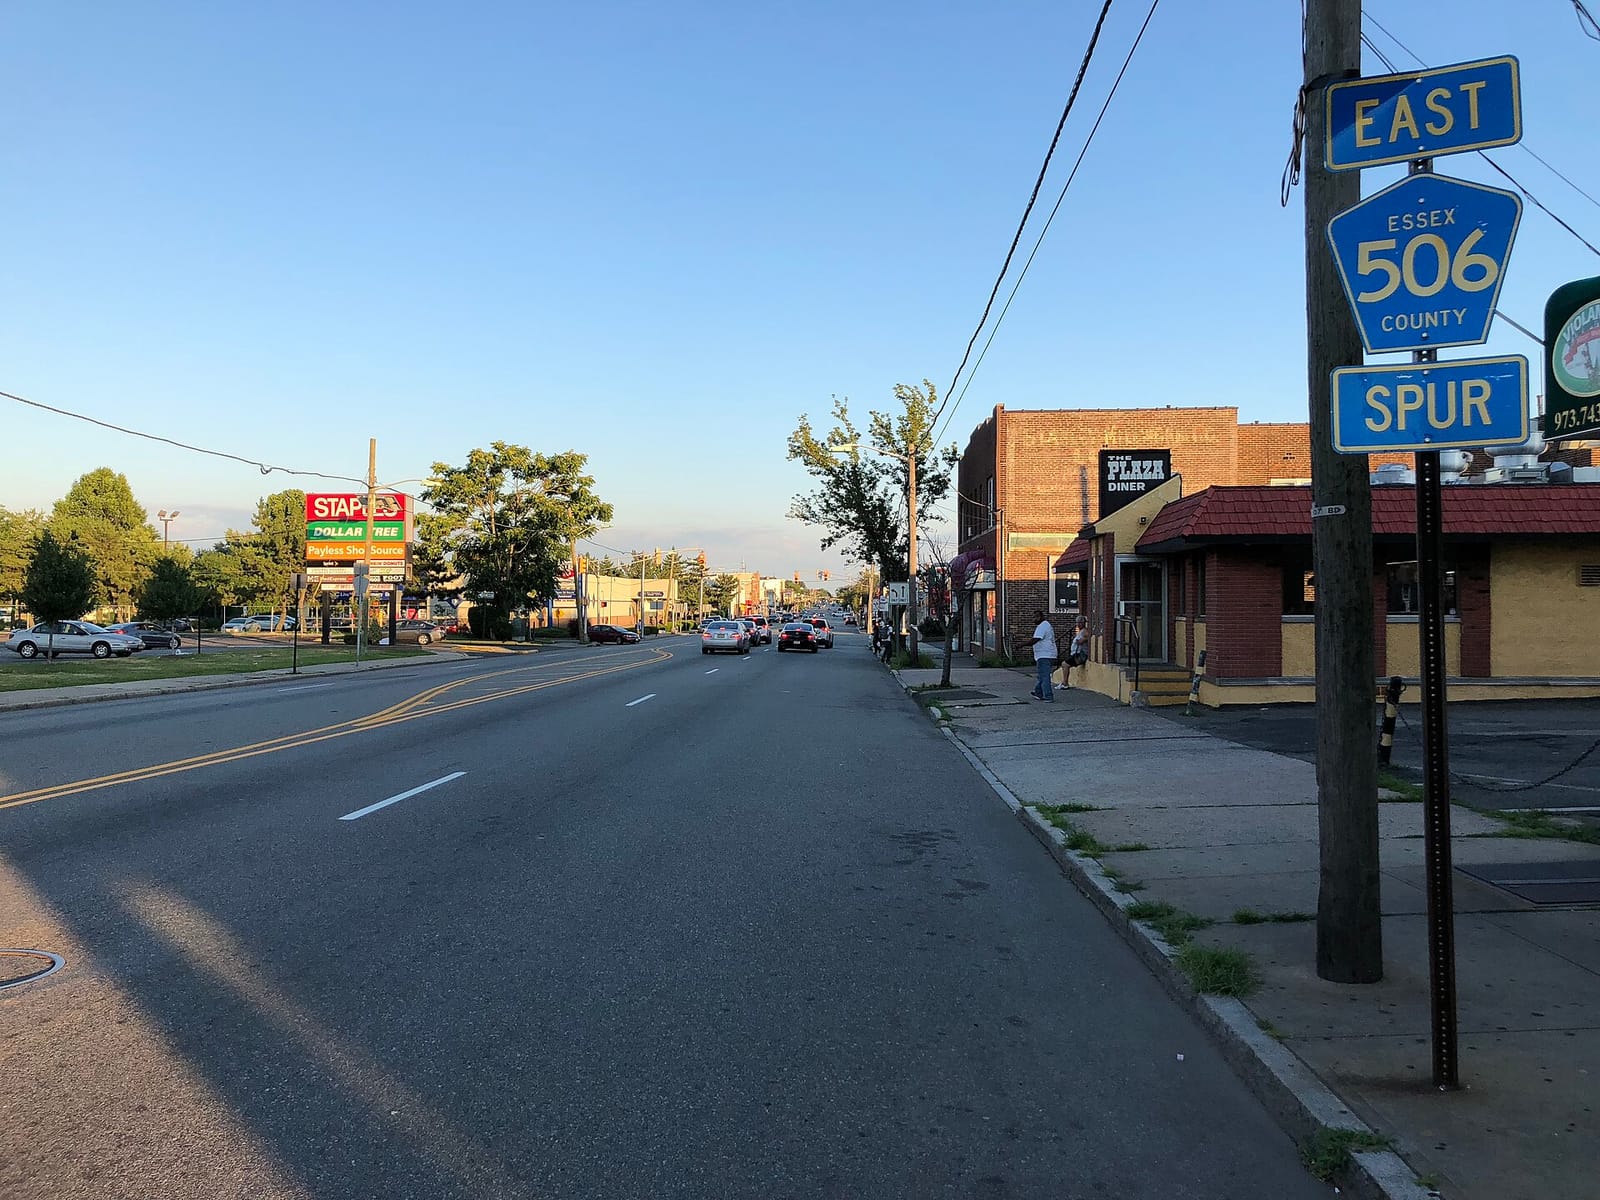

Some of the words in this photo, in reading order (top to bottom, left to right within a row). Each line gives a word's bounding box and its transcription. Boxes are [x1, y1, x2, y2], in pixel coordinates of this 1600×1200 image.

[1355, 81, 1487, 148] EAST
[1388, 208, 1456, 233] ESSEX
[1357, 228, 1499, 303] 506
[1381, 308, 1468, 332] COUNTY
[1365, 379, 1492, 432] SPUR
[1107, 460, 1164, 480] PLAZA
[1108, 482, 1145, 491] DINER
[313, 527, 363, 537] DOLLAR
[308, 546, 344, 556] Payless
[346, 545, 365, 555] Sho
[370, 546, 403, 555] Source
